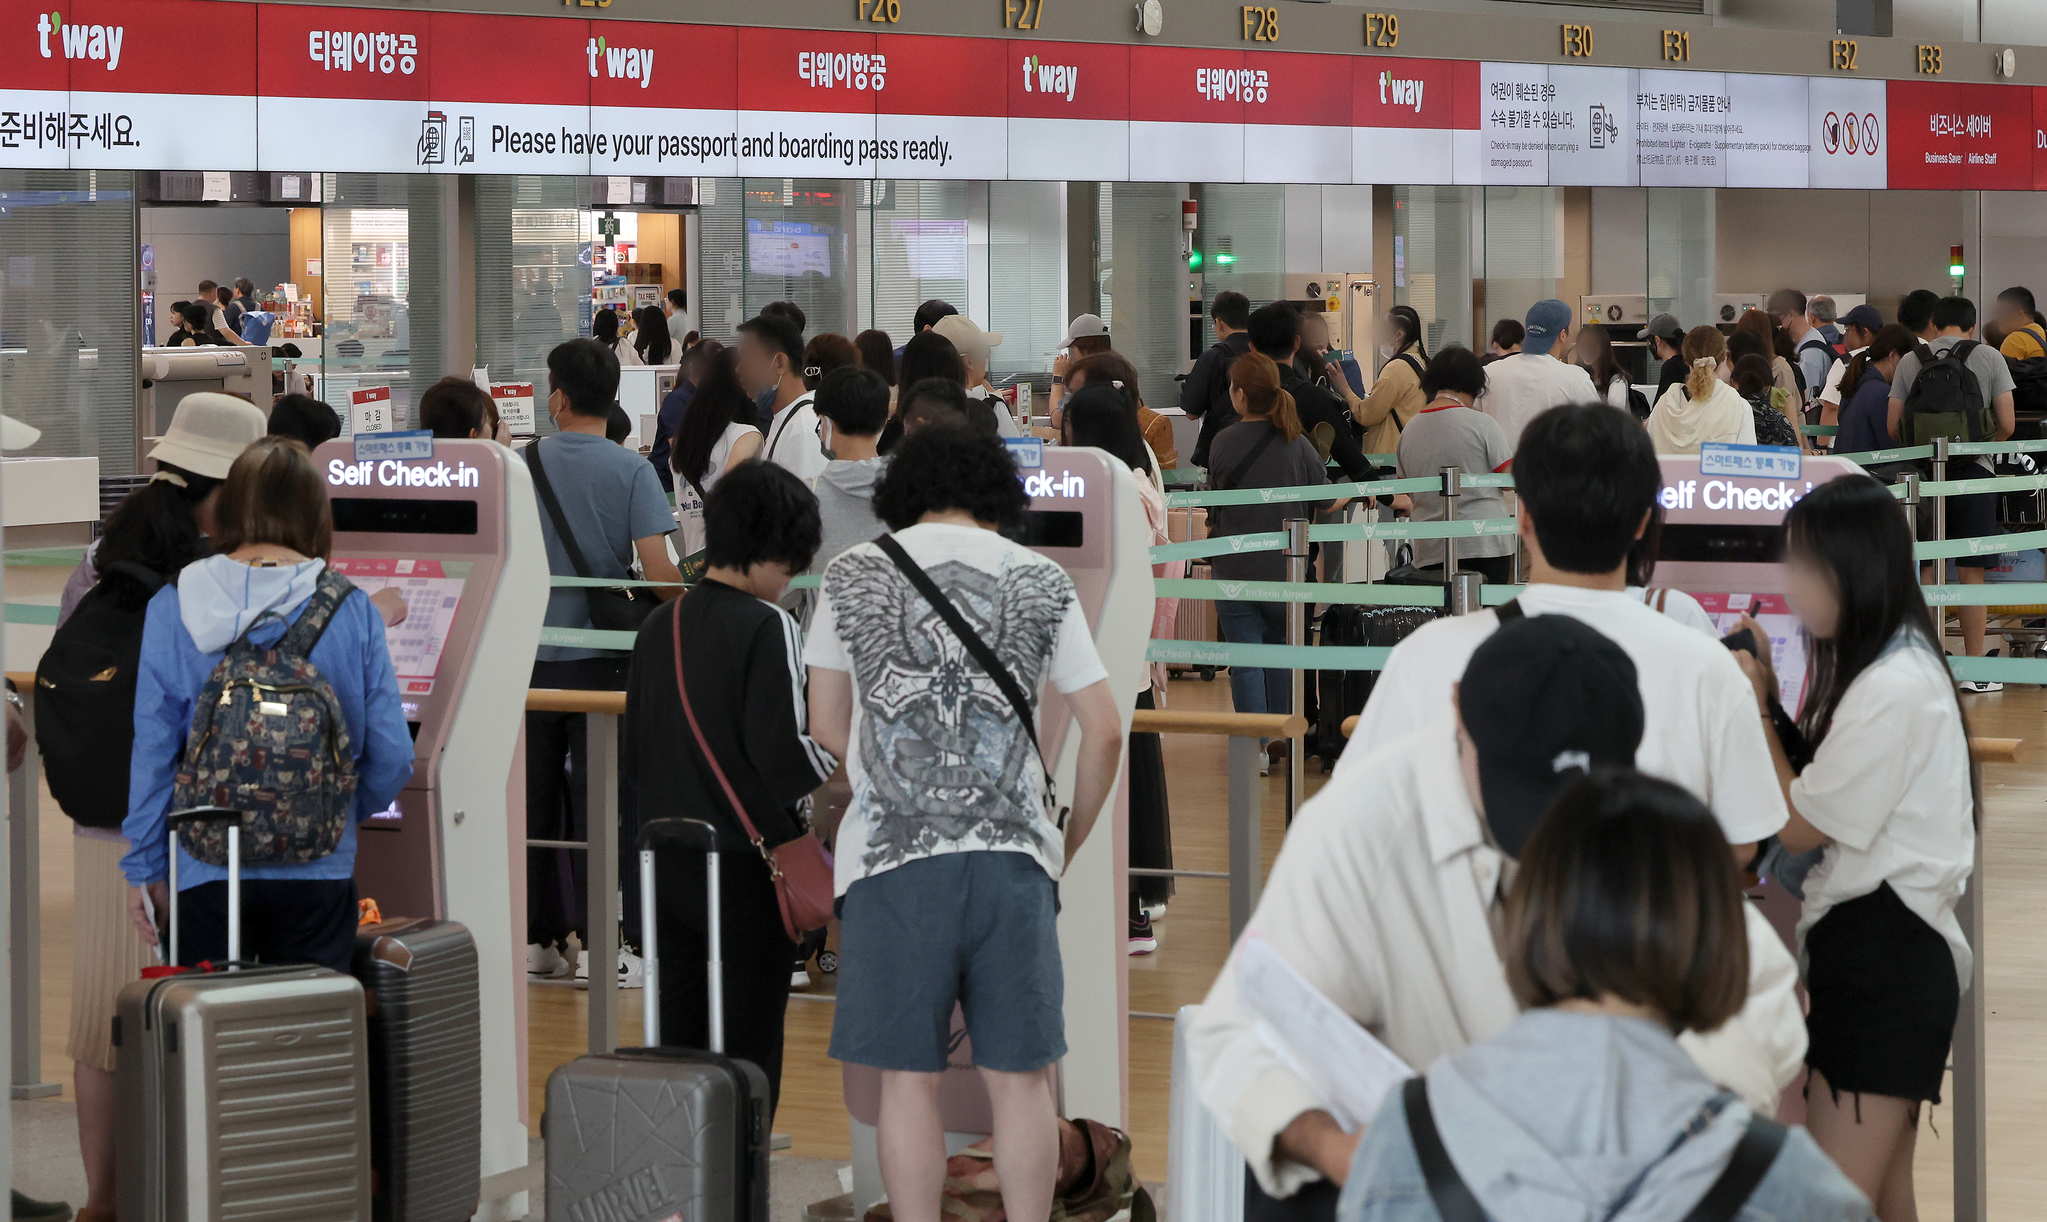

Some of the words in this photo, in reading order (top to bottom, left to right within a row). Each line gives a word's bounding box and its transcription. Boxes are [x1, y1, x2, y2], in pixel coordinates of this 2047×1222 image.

[1004, 0, 1043, 30] F27
[1242, 5, 1280, 42] F28
[37, 10, 125, 72] t'way
[1364, 13, 1399, 48] F29
[1562, 24, 1593, 57] F30
[309, 30, 418, 75] 티웨이항공
[1663, 30, 1690, 62] F31
[1831, 40, 1858, 71] F32
[1918, 44, 1943, 74] F33
[586, 35, 654, 89] t'way
[798, 51, 887, 91] 티웨이항공
[1023, 54, 1078, 102] t'way
[1196, 67, 1269, 103] 티웨이항공
[1379, 70, 1424, 113] t'way
[1491, 82, 1513, 101] 여권이
[1515, 82, 1538, 102] 훼손된
[1540, 83, 1556, 102] 경우
[1636, 92, 1658, 111] 부치는
[1660, 92, 1687, 113] 짐(위탁)
[1688, 94, 1715, 113] 금지물품
[1717, 95, 1731, 113] 안내
[0, 111, 141, 150] 준비해주세요.
[1491, 109, 1506, 128] 수속
[1508, 109, 1531, 129] 불가할
[1533, 110, 1541, 129] 수
[1542, 111, 1575, 130] 있습니다.
[1930, 113, 1965, 138] 비즈니스
[1966, 114, 1992, 138] 세이버
[492, 124, 556, 155] Please
[561, 126, 607, 156] have
[611, 133, 653, 162] your
[657, 131, 738, 164] passport
[741, 131, 774, 158] and
[779, 132, 854, 166] boarding
[858, 140, 899, 166] pass
[902, 137, 954, 168] ready.
[1491, 140, 1511, 150] Check-in
[1512, 142, 1521, 151] may
[1522, 141, 1527, 151] be
[1528, 141, 1543, 151] denied
[1544, 142, 1557, 151] when
[1557, 143, 1575, 153] carrying
[1636, 139, 1658, 148] Prohibited
[1658, 139, 1669, 148] items
[1689, 140, 1711, 151] E-cigarette
[1714, 141, 1744, 152] Supplementary
[1745, 142, 1759, 152] battery
[1778, 143, 1794, 151] checked
[1925, 152, 1948, 164] Business
[1948, 152, 1963, 164] Saver
[1968, 153, 1984, 164] Airline
[1985, 153, 1997, 165] Staff
[1491, 158, 1512, 169] damaged
[1512, 159, 1533, 169] passport.
[365, 410, 371, 422] 마
[375, 409, 381, 421] 감
[366, 423, 382, 432] CLOSED
[328, 459, 374, 487] Self
[377, 459, 479, 489] Check-in
[1705, 454, 1752, 469] 스마트패스
[1755, 456, 1774, 470] 등록
[1024, 469, 1085, 498] ck-in
[1659, 480, 1698, 510] elf
[1171, 497, 1187, 505] Incheon
[1188, 497, 1202, 505] Airport
[1243, 541, 1262, 549] Incheon
[1263, 539, 1280, 548] Airport
[1245, 588, 1280, 599] Incheon
[1282, 589, 1314, 601] Airport
[1926, 591, 1960, 603] Airport
[551, 633, 585, 644] Airport
[1151, 648, 1192, 660] Incheon
[1193, 649, 1230, 662] Airport
